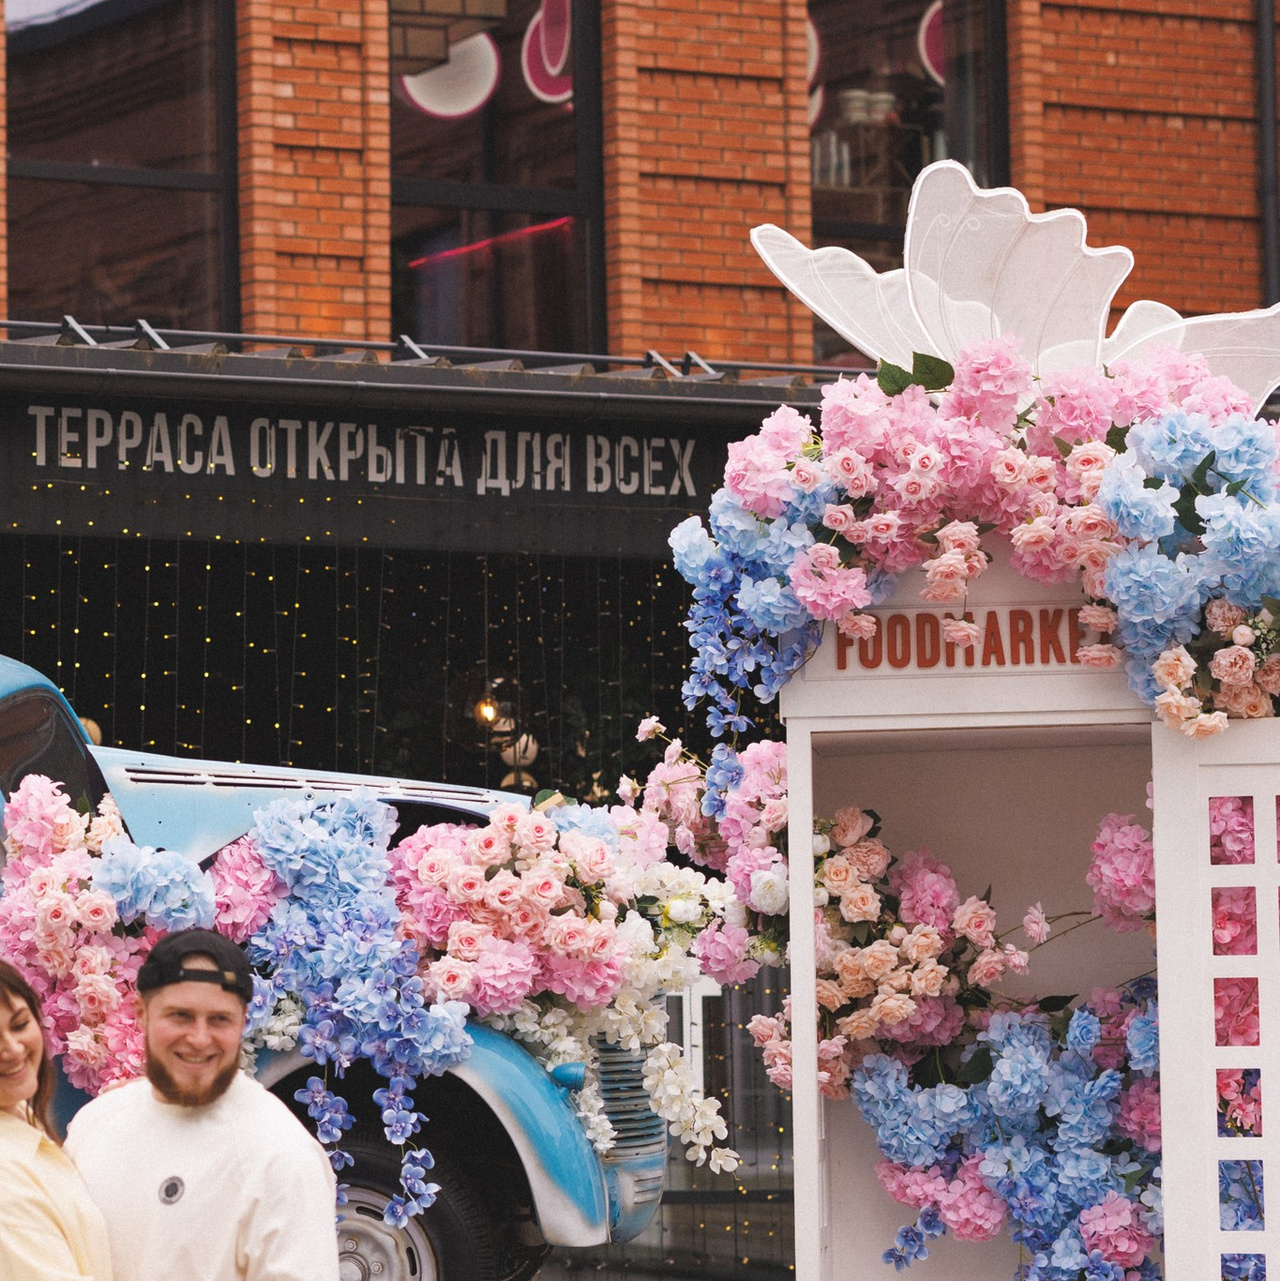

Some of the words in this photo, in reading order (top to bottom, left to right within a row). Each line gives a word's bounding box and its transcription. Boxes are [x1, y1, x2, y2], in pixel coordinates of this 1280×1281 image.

[28, 406, 236, 476] ТЕРРАСА
[250, 419, 464, 487] ОТКРЫТА
[477, 430, 572, 496] ДЛЯ
[587, 435, 697, 497] ВСЕХ
